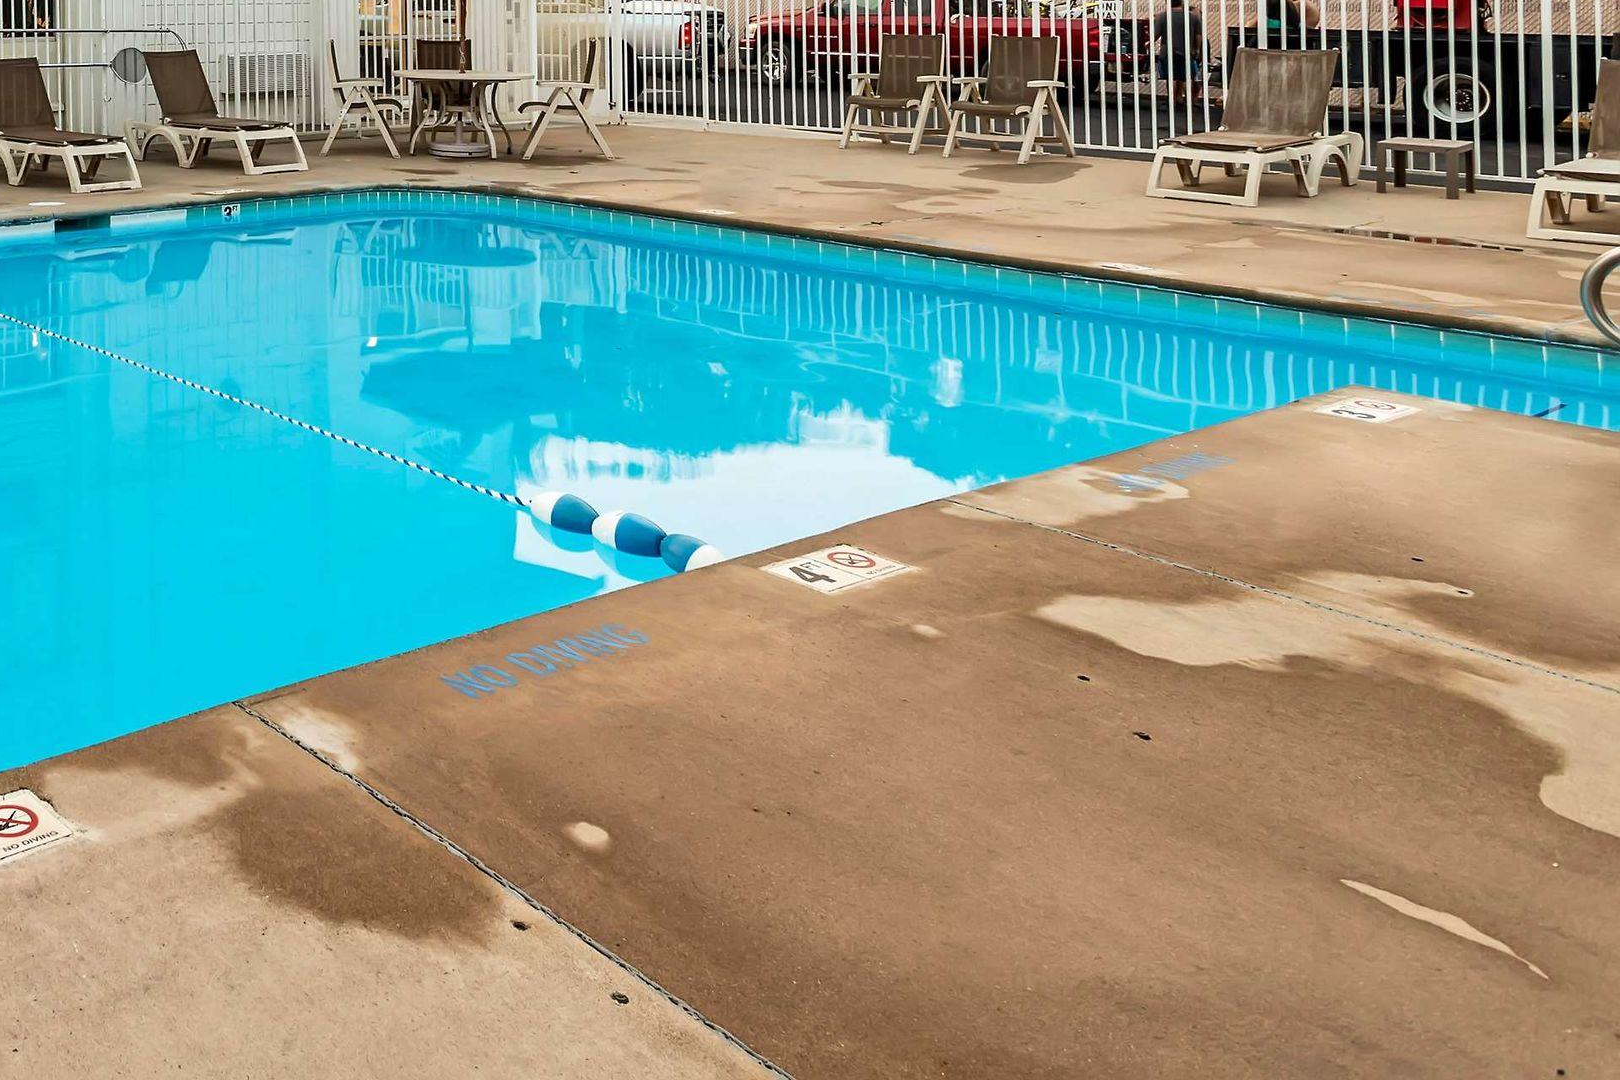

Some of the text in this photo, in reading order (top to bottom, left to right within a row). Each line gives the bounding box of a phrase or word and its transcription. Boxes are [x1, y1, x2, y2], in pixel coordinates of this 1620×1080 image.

[789, 566, 836, 583] 4
[439, 623, 650, 700] NO DIVING
[2, 831, 59, 852] NO DIVING
